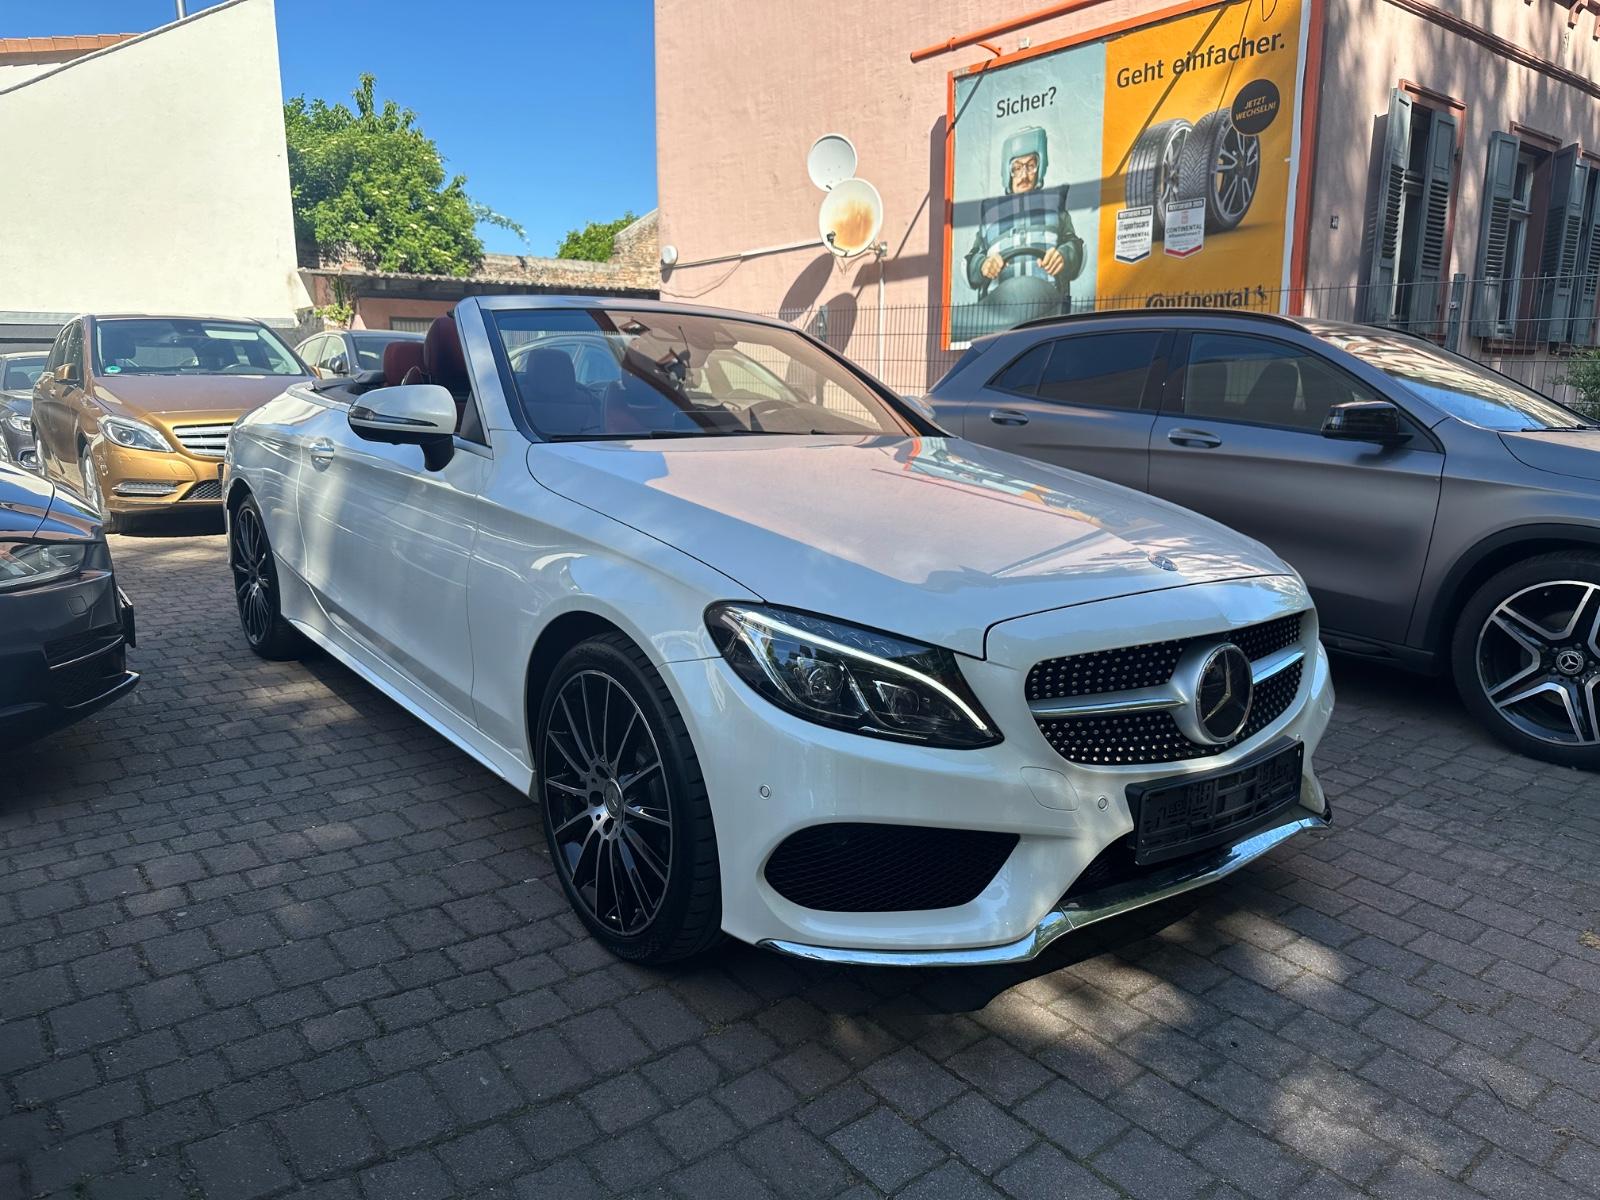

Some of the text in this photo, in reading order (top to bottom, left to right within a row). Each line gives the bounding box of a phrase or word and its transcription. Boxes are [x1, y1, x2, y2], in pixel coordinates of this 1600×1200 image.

[1116, 32, 1285, 89] Geht einfacher.
[995, 86, 1057, 118] Sicher?
[1235, 101, 1277, 121] WECHSELN!
[1244, 95, 1267, 110] JETZT
[1117, 232, 1150, 240] CONTINENTAL
[1166, 224, 1202, 233] CONTINENTAL
[1145, 287, 1249, 308] Continental
